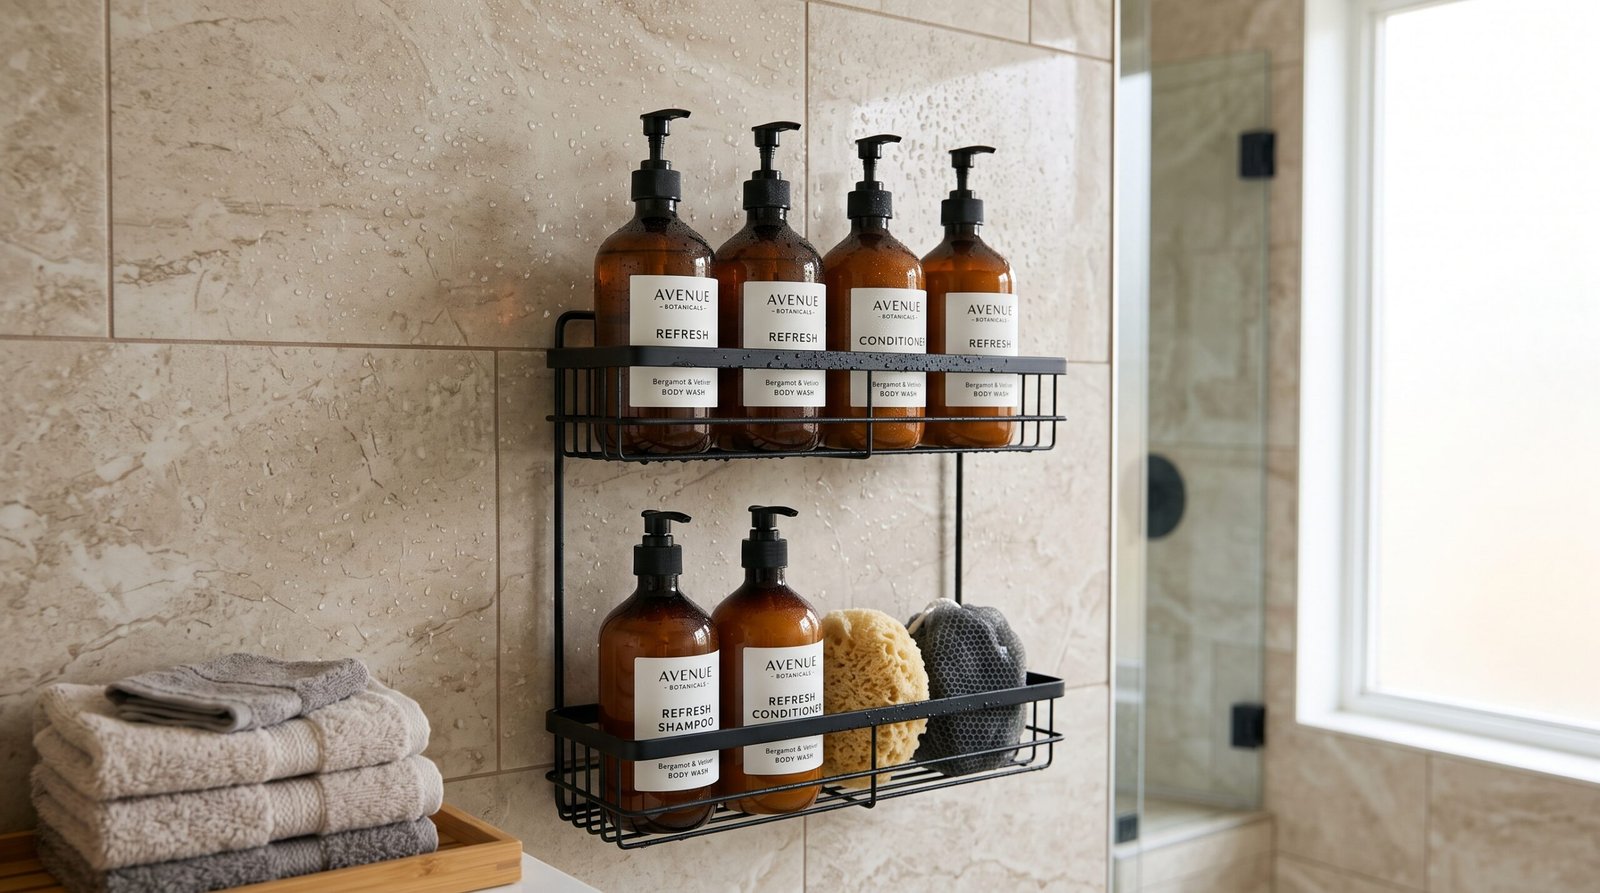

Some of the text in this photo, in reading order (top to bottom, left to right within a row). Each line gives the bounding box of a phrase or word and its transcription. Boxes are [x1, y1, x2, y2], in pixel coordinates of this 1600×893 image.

[654, 289, 709, 302] AVENUE
[767, 294, 818, 307] AVENUE
[873, 300, 921, 313] AVENUE
[967, 304, 1013, 316] AVENUE
[656, 328, 709, 340] REFRESH
[769, 332, 818, 343] REFRESH
[969, 339, 1012, 349] REFRESH
[652, 378, 686, 387] Bergamot
[765, 379, 797, 388] Bergamot
[872, 381, 901, 389] Bergamot
[965, 382, 994, 390] Bergamot
[765, 656, 817, 671] AVENUE
[658, 666, 713, 682] AVENUE
[776, 671, 811, 679] BOTANICALS
[669, 682, 706, 691] BOTANICALS
[768, 692, 816, 706] REFRESH
[662, 704, 711, 719] REFRESH
[752, 703, 822, 719] CONDITIONER
[658, 717, 714, 732] SHAMPOO
[765, 747, 796, 756] Bergamot
[775, 753, 814, 764] BODY WASH
[658, 762, 691, 771] Bergamot
[691, 768, 709, 777] WASH
